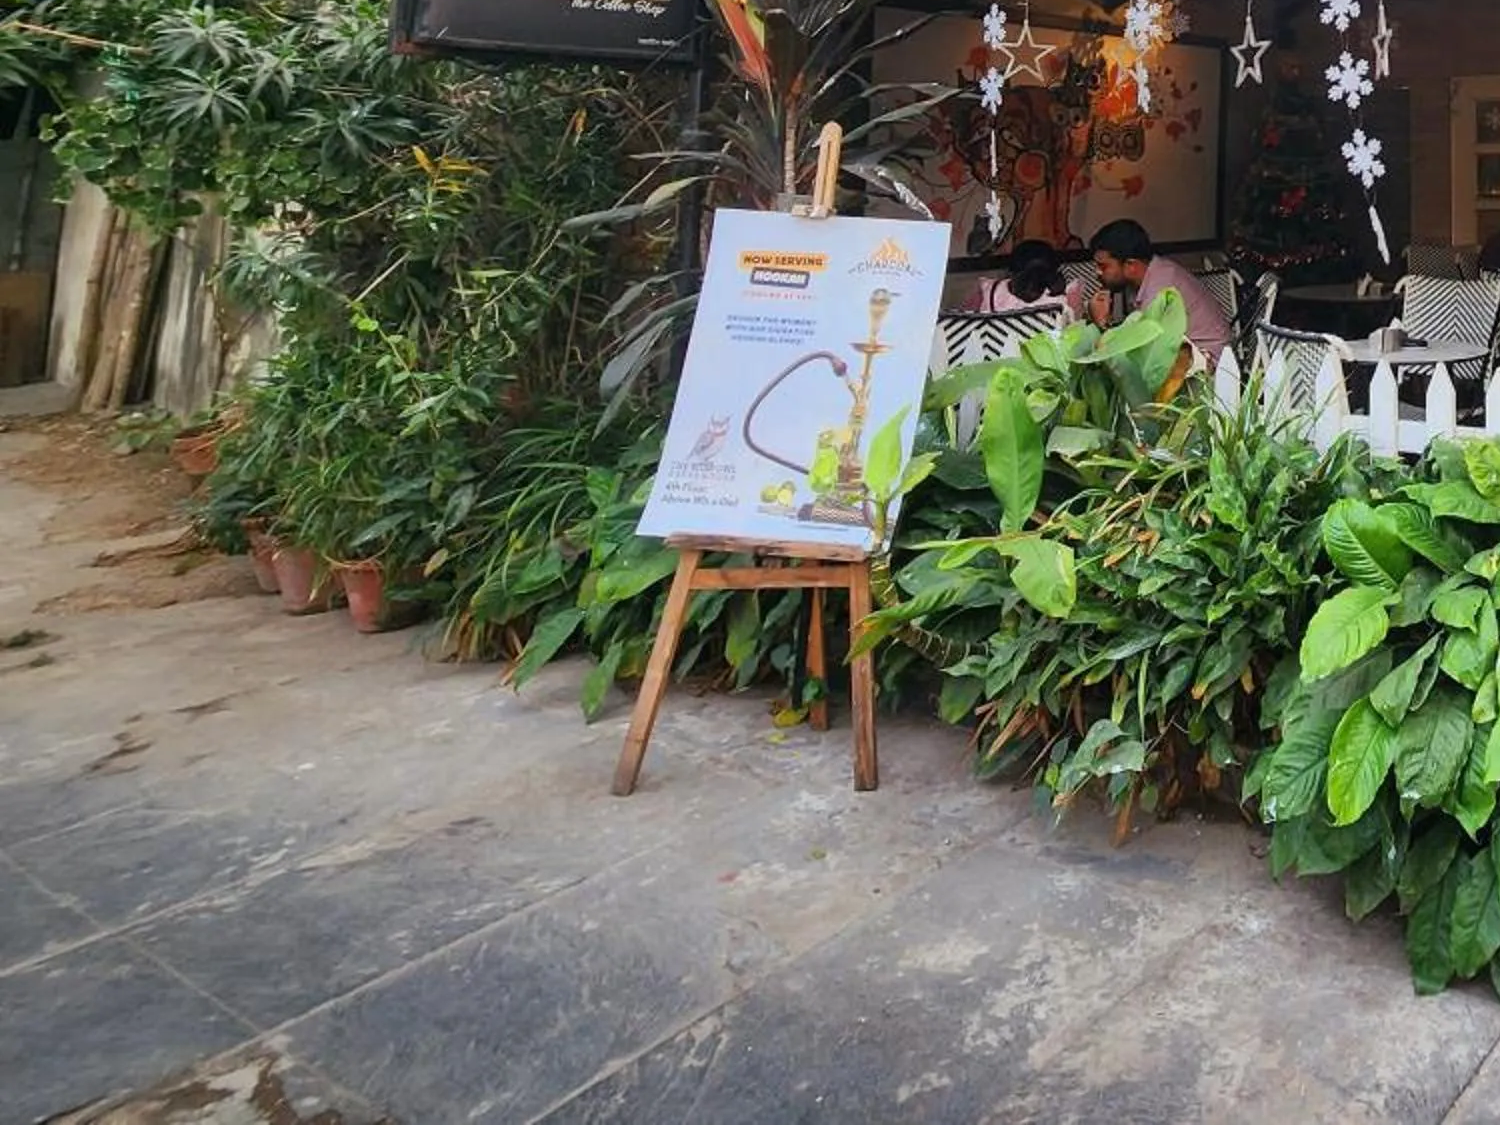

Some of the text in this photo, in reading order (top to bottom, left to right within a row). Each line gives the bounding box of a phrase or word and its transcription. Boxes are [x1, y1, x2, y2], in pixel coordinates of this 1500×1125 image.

[633, 0, 667, 18] Shop
[743, 255, 823, 266] NOW SERVING
